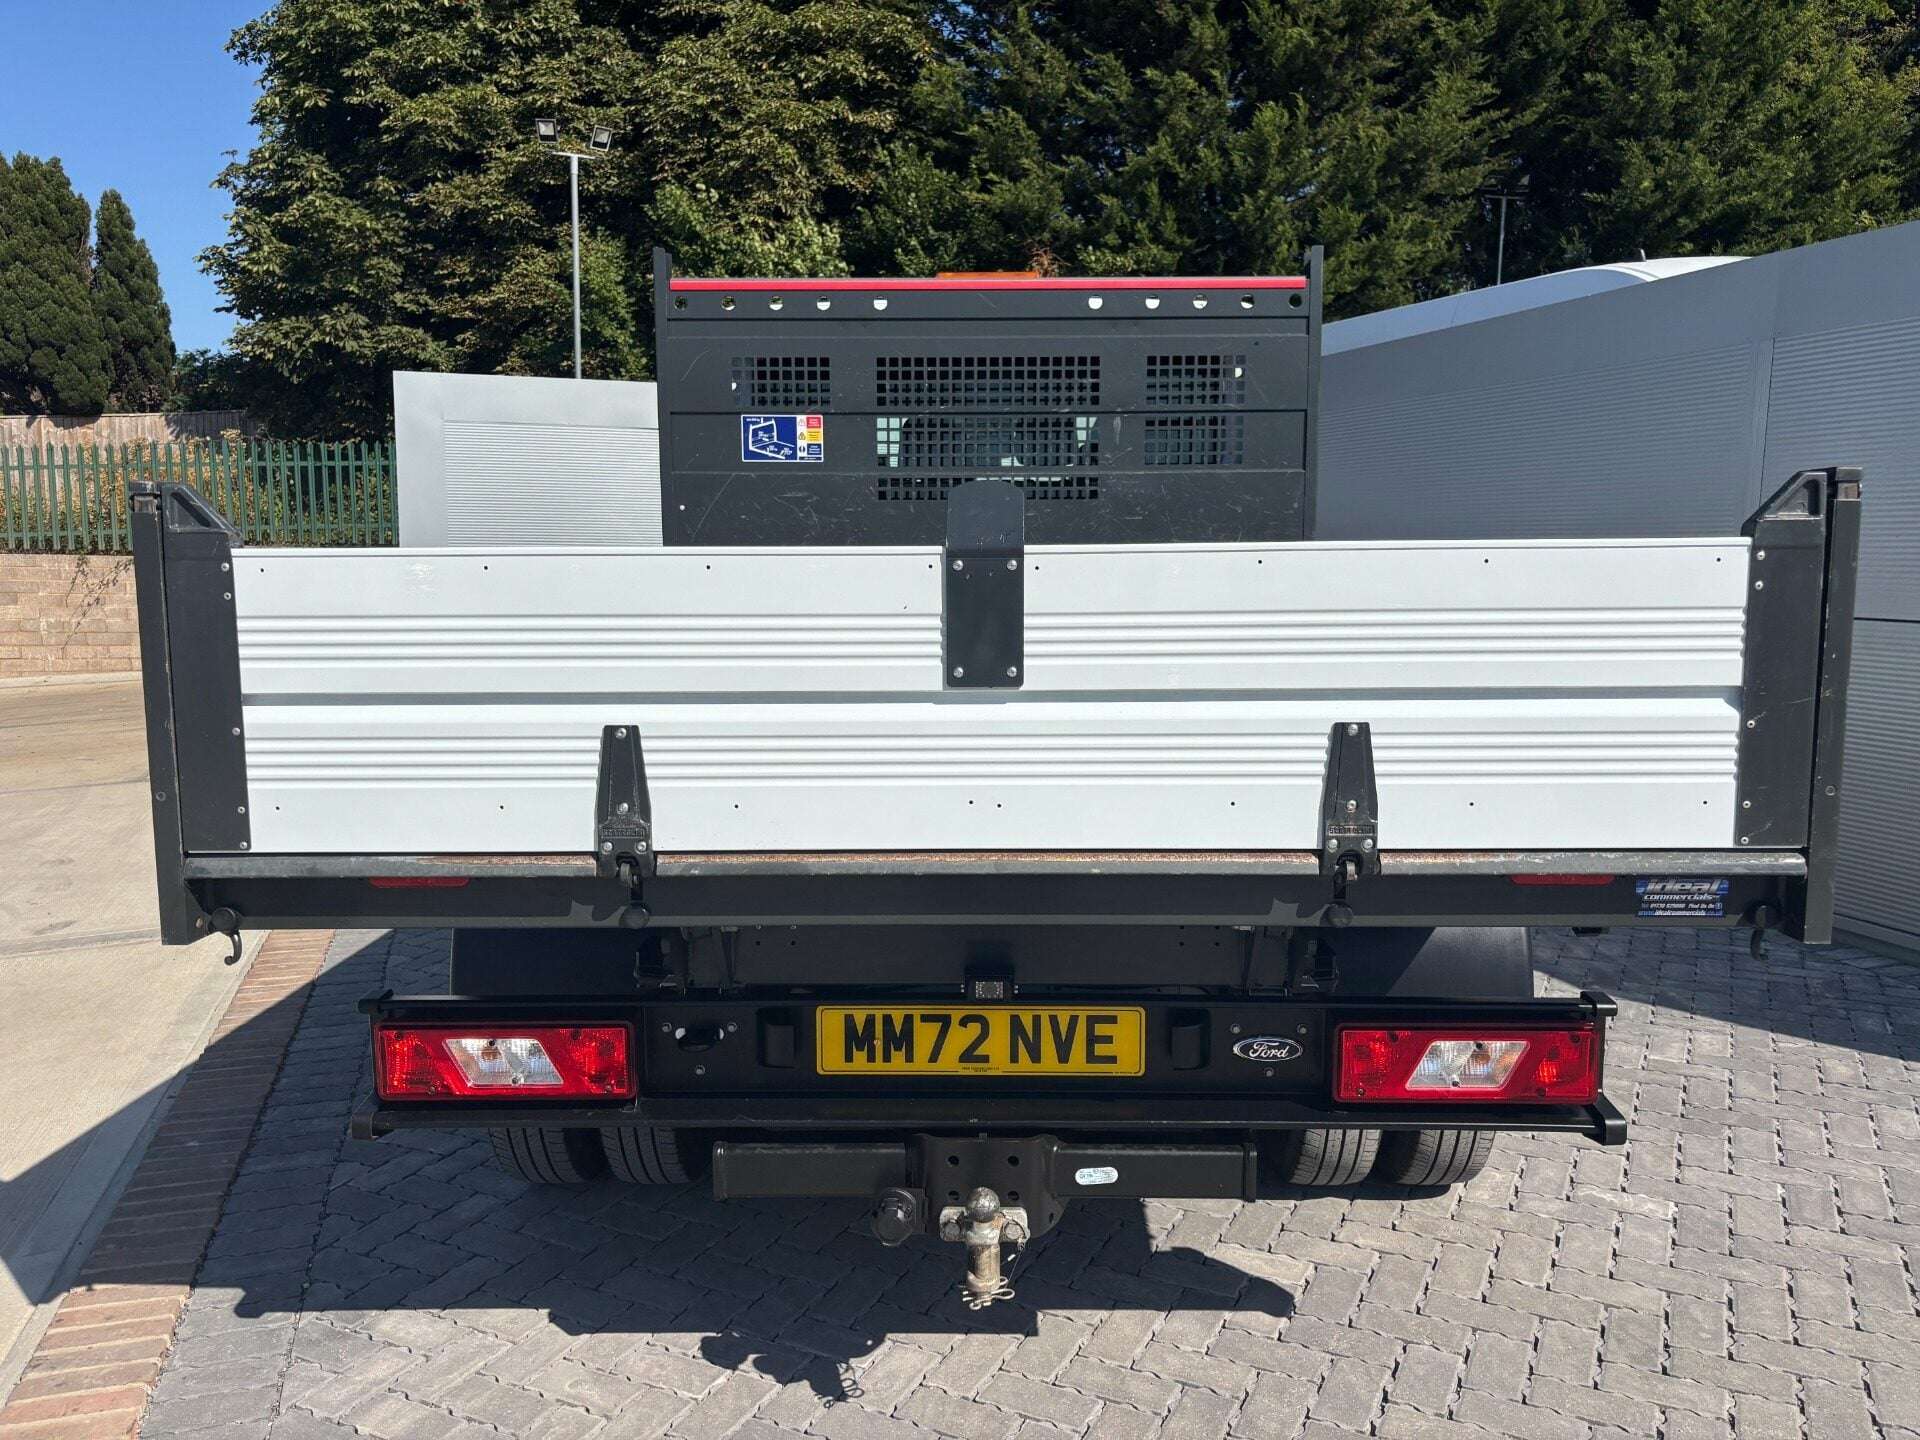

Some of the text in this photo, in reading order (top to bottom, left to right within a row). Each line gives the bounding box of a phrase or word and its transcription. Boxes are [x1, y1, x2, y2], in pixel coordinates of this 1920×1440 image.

[1645, 879, 1722, 894] ideal
[1643, 893, 1713, 901] commercials
[843, 1013, 1119, 1065] MM72 NVE
[1248, 1041, 1290, 1058] Ford
